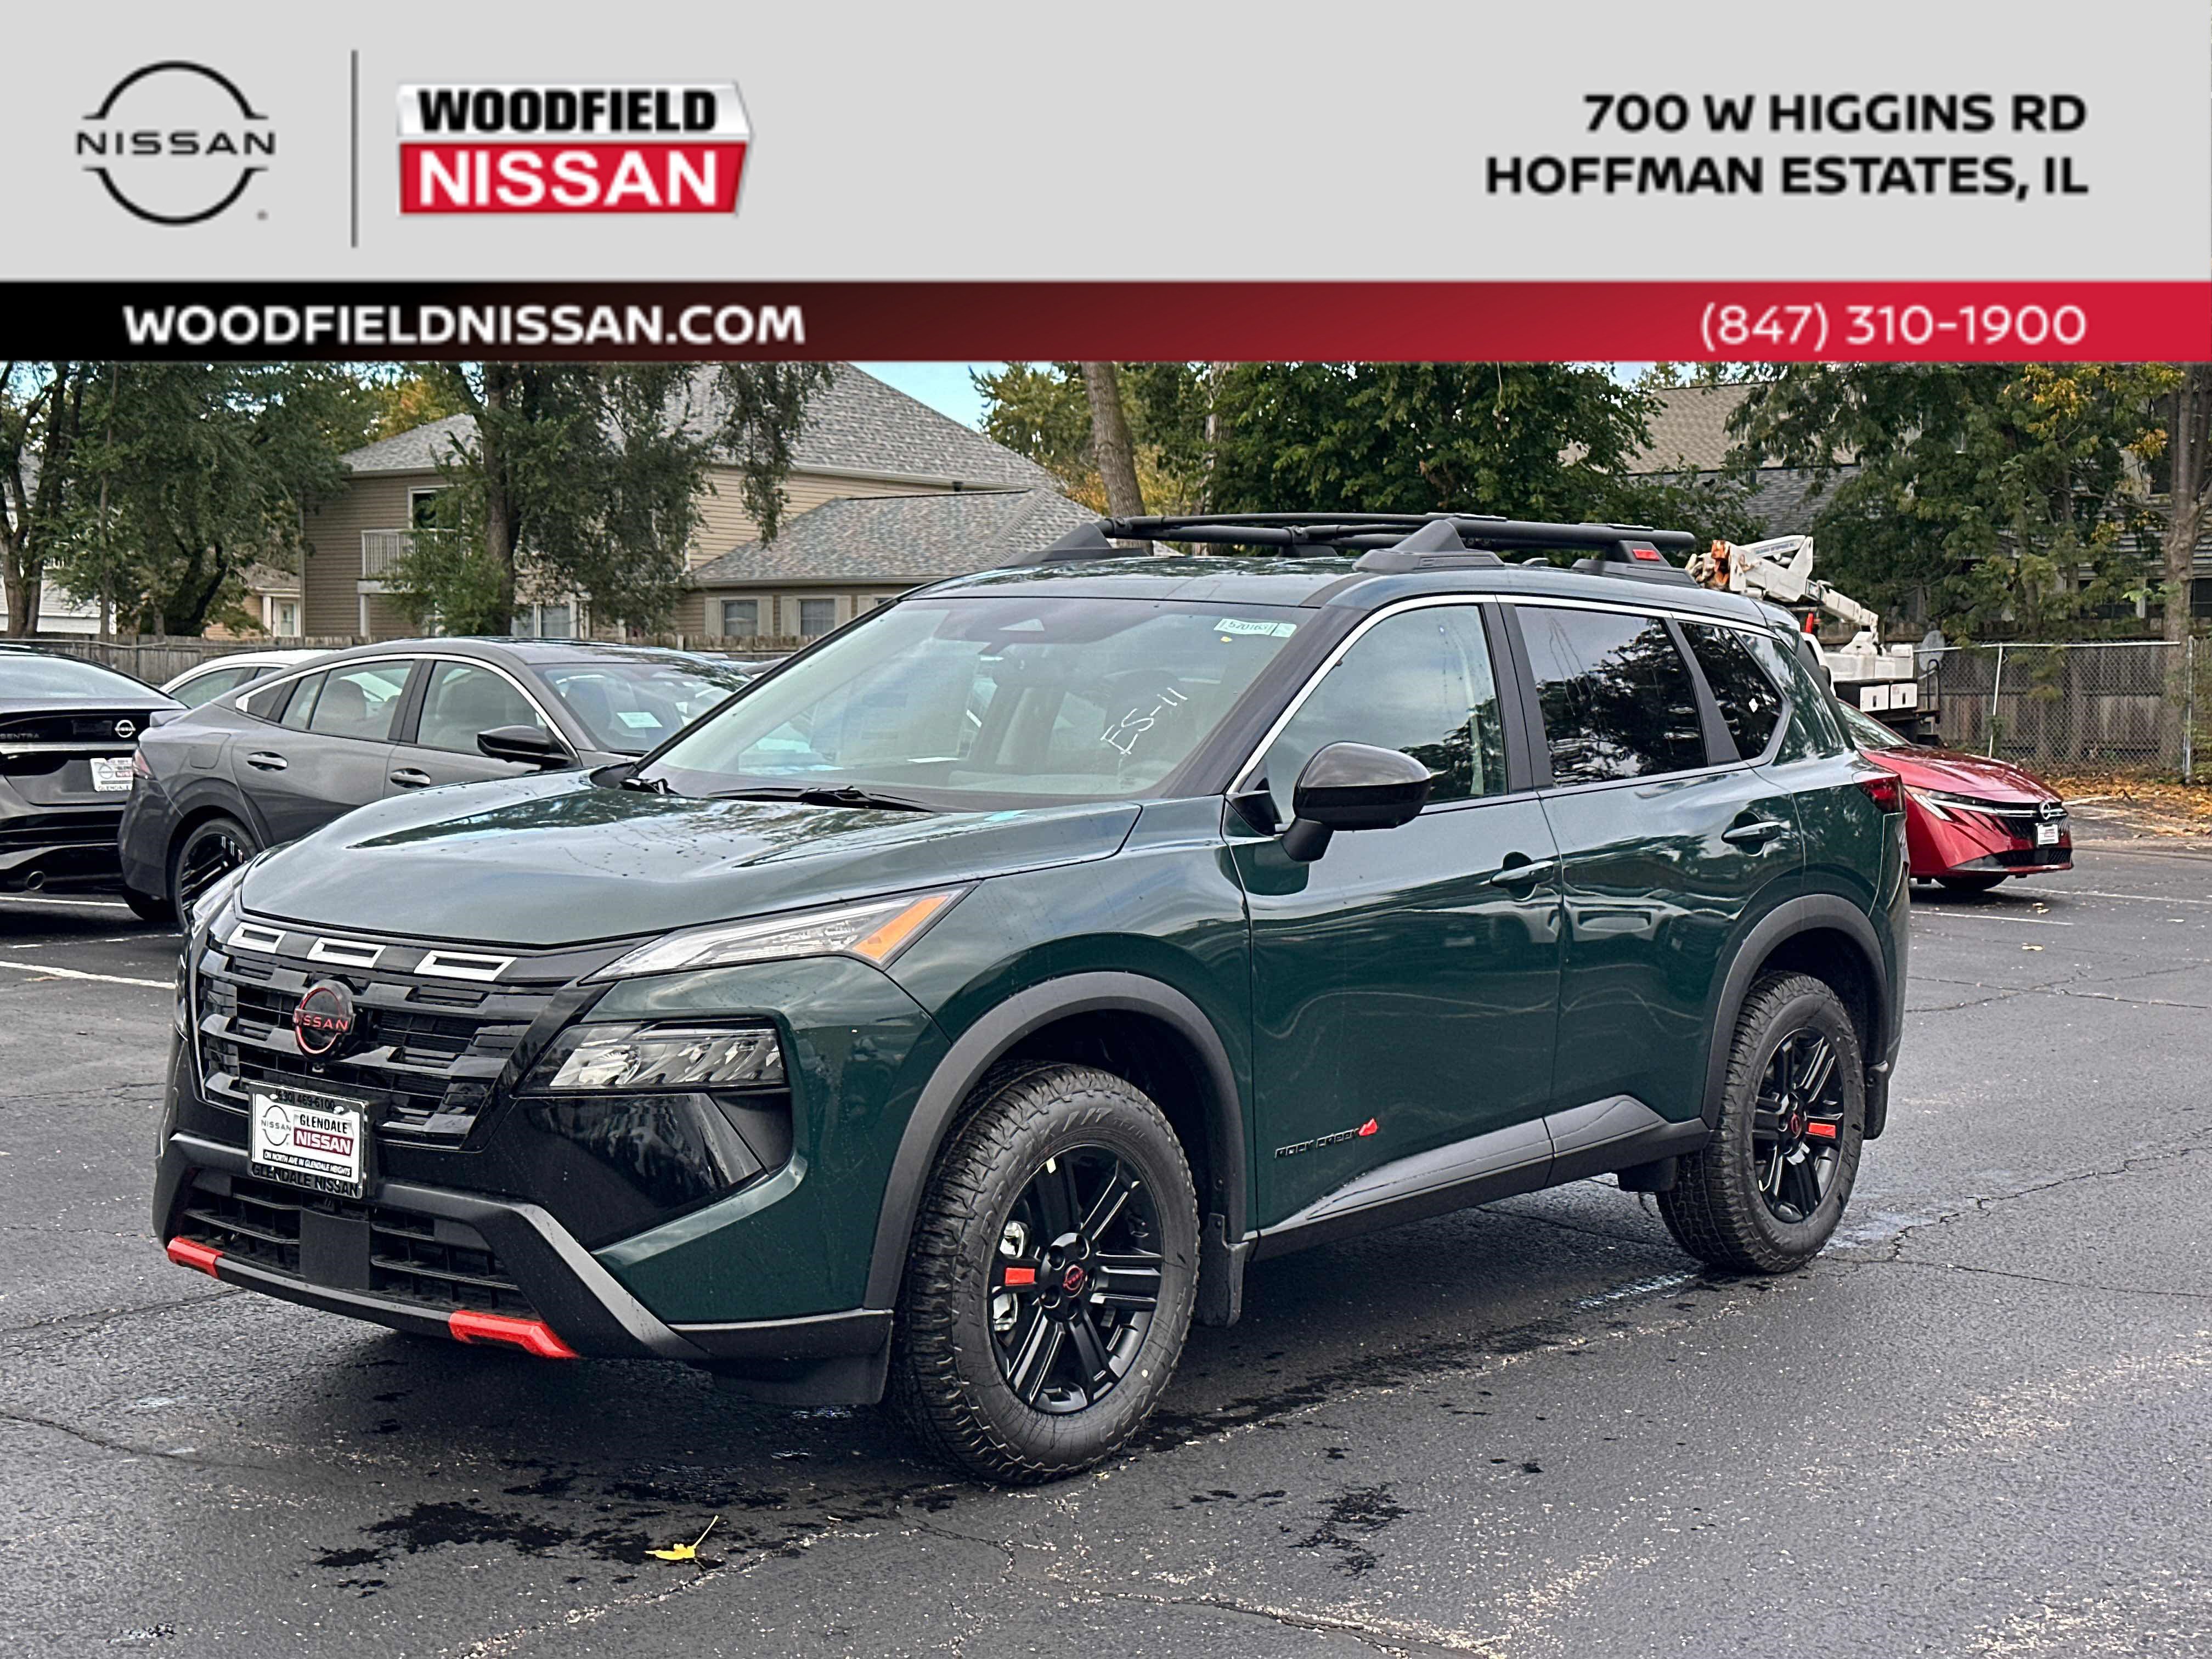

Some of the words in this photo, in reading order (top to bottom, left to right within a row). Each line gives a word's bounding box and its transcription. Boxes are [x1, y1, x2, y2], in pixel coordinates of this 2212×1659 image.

[261, 1119, 292, 1132] NISSAN
[300, 1114, 348, 1134] GLENDALE
[296, 1130, 351, 1155] NISSAN
[264, 1150, 272, 1160] ON
[272, 1152, 288, 1163] NORTH
[305, 1158, 330, 1171] GLENDALE
[330, 1164, 351, 1176] HEIGHTS
[252, 1163, 313, 1188] GLENDALE
[314, 1175, 359, 1198] NISSAN
